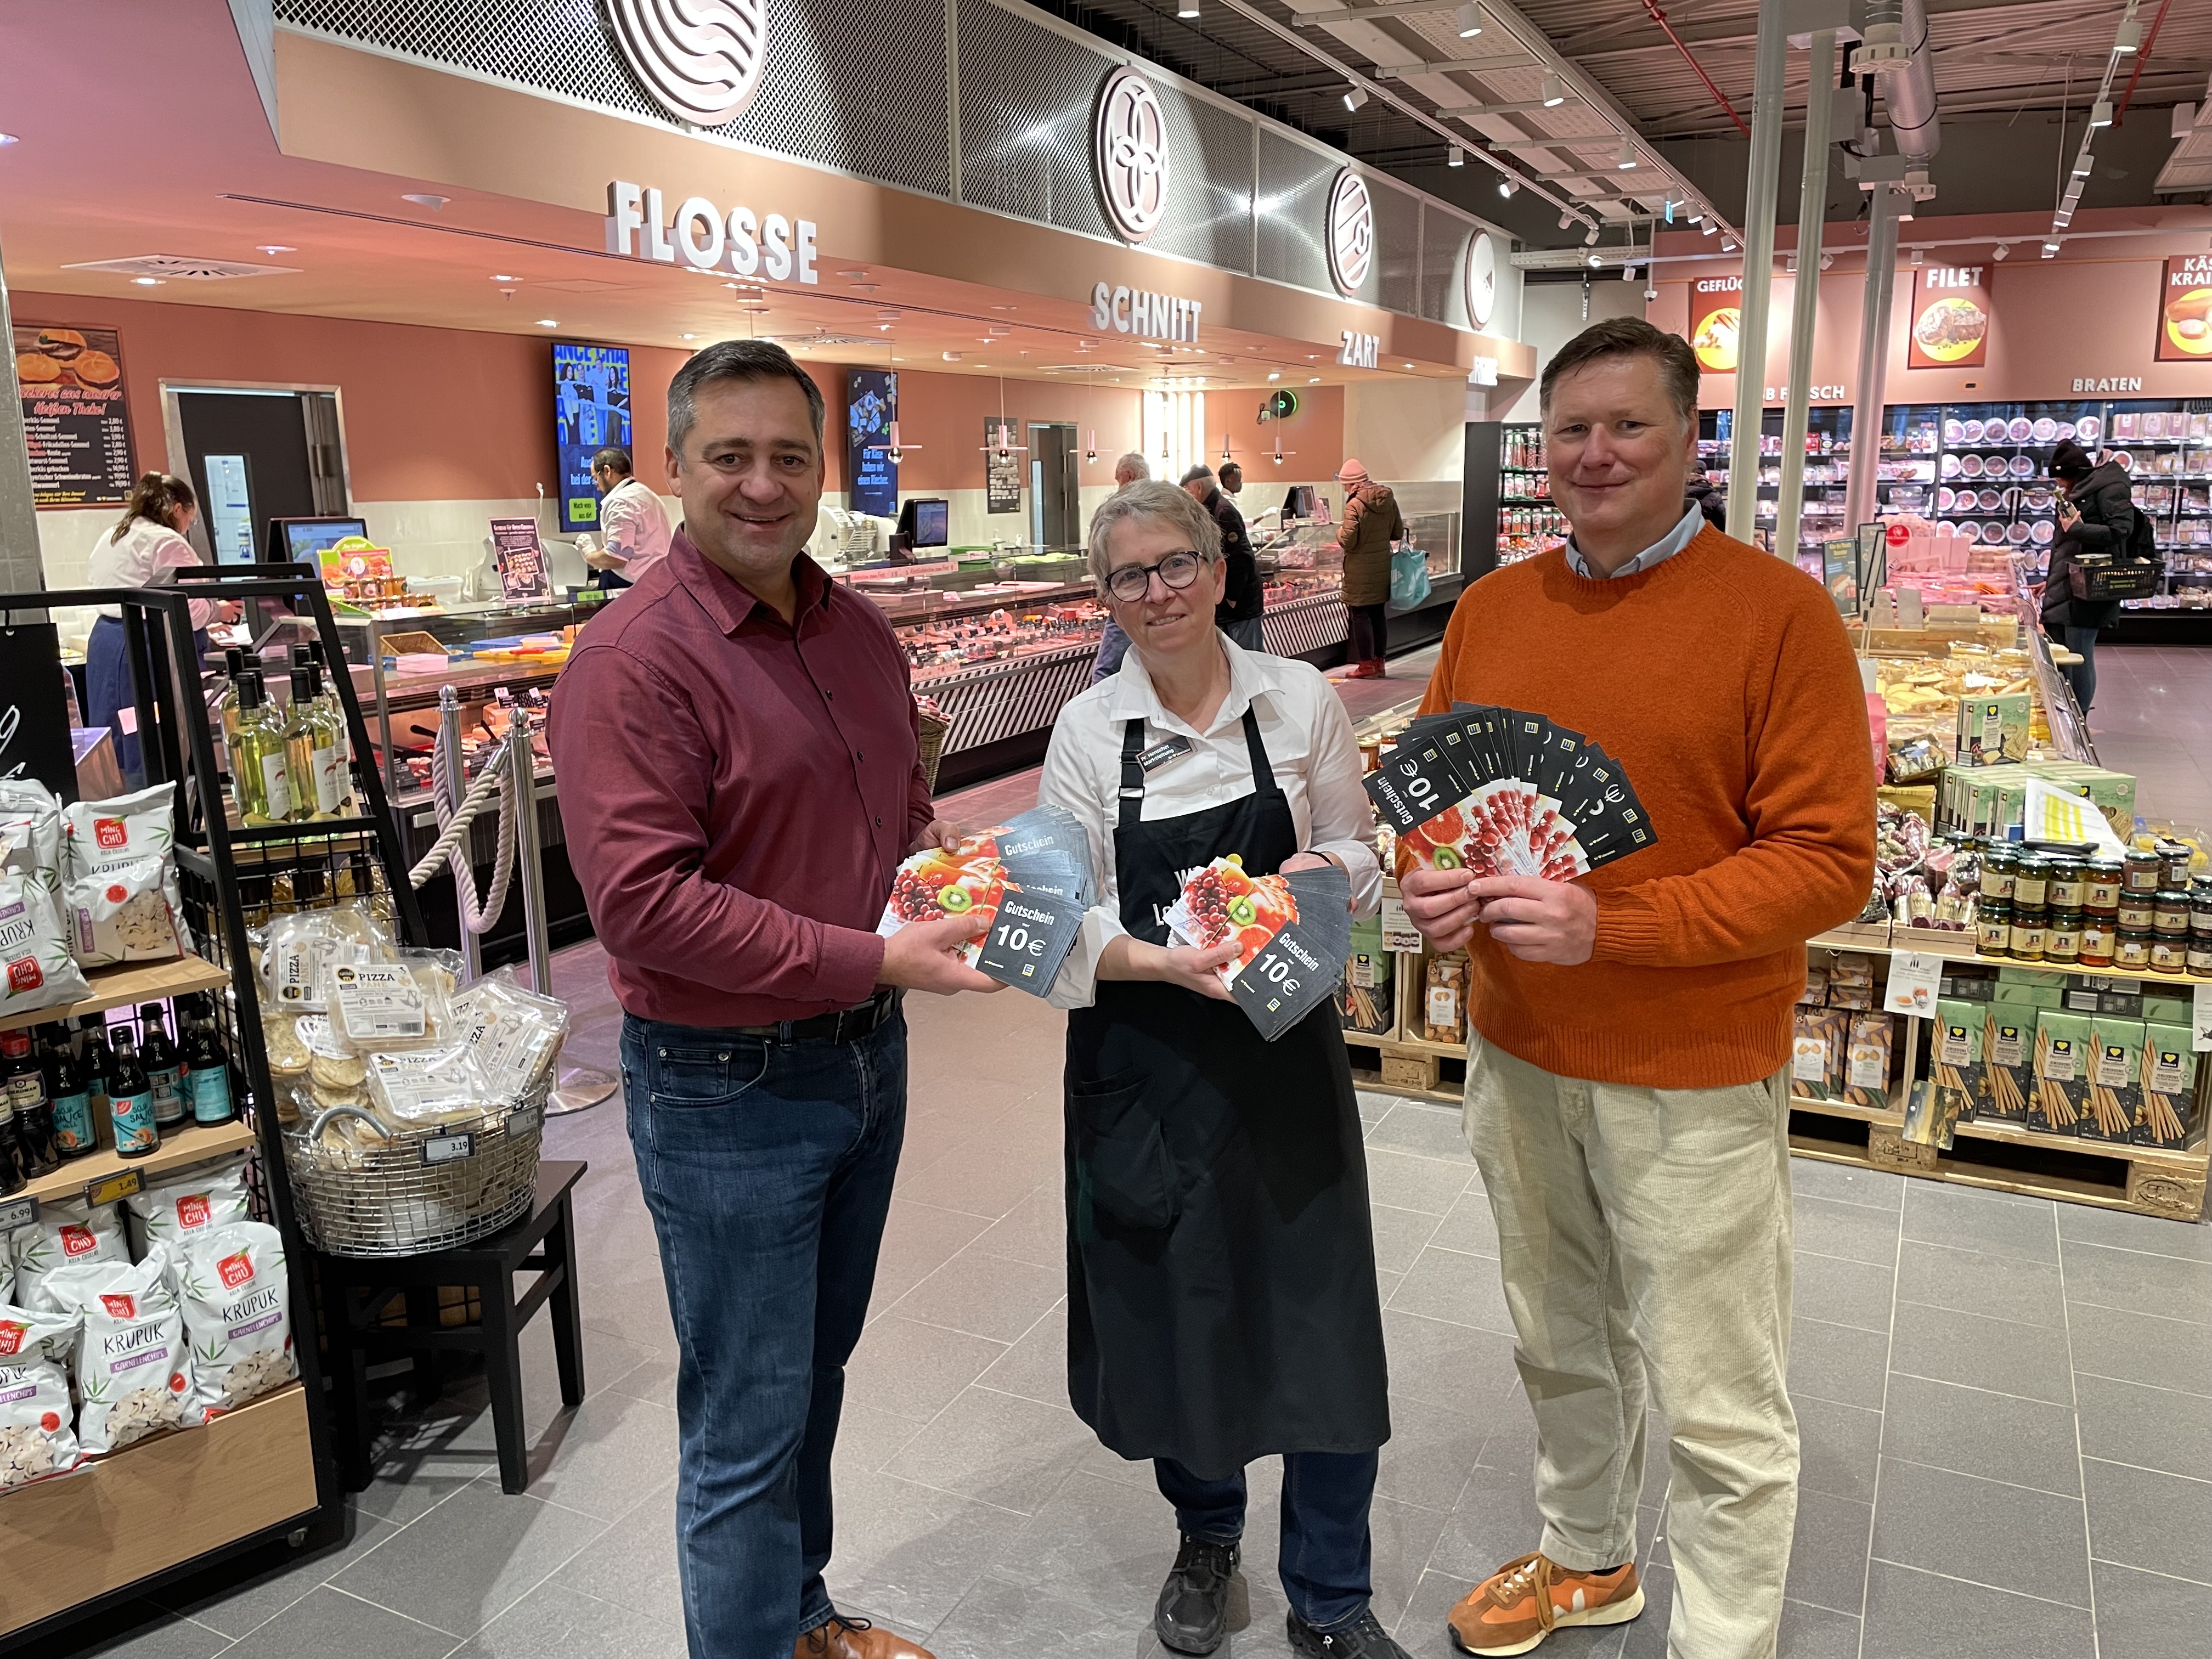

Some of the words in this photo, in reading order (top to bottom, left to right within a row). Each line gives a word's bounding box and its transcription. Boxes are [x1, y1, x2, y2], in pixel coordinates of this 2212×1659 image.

[609, 180, 818, 285] FLOSSE
[1926, 266, 1984, 289] FILET
[1093, 282, 1201, 342] SCHNITT
[1341, 330, 1380, 369] ZART
[2071, 377, 2142, 393] BRATEN
[1143, 748, 1175, 766] Marktleitung
[1377, 776, 1414, 826] Gutschein
[100, 825, 121, 834] MING
[102, 832, 122, 845] CHU
[1005, 834, 1054, 856] Gutschein
[1005, 900, 1056, 926] Gutschein
[1279, 933, 1320, 972] Gutschein
[289, 954, 300, 984] PIZZA
[358, 973, 396, 981] PIZZA
[360, 980, 389, 989] PANE
[450, 1141, 468, 1152] 3.19
[117, 1177, 138, 1191] 1.49
[10, 1207, 30, 1221] 6.99
[183, 1201, 204, 1213] MING
[185, 1209, 206, 1224] CHU
[70, 1237, 92, 1251] CHU
[224, 1259, 245, 1275] MING
[228, 1266, 249, 1284] CHU
[222, 1288, 278, 1323] KRUPUK
[232, 1314, 279, 1338] GARNELENCHIPS
[104, 1322, 164, 1355] KRUPUK
[114, 1350, 164, 1371] GARNELENCHIPS
